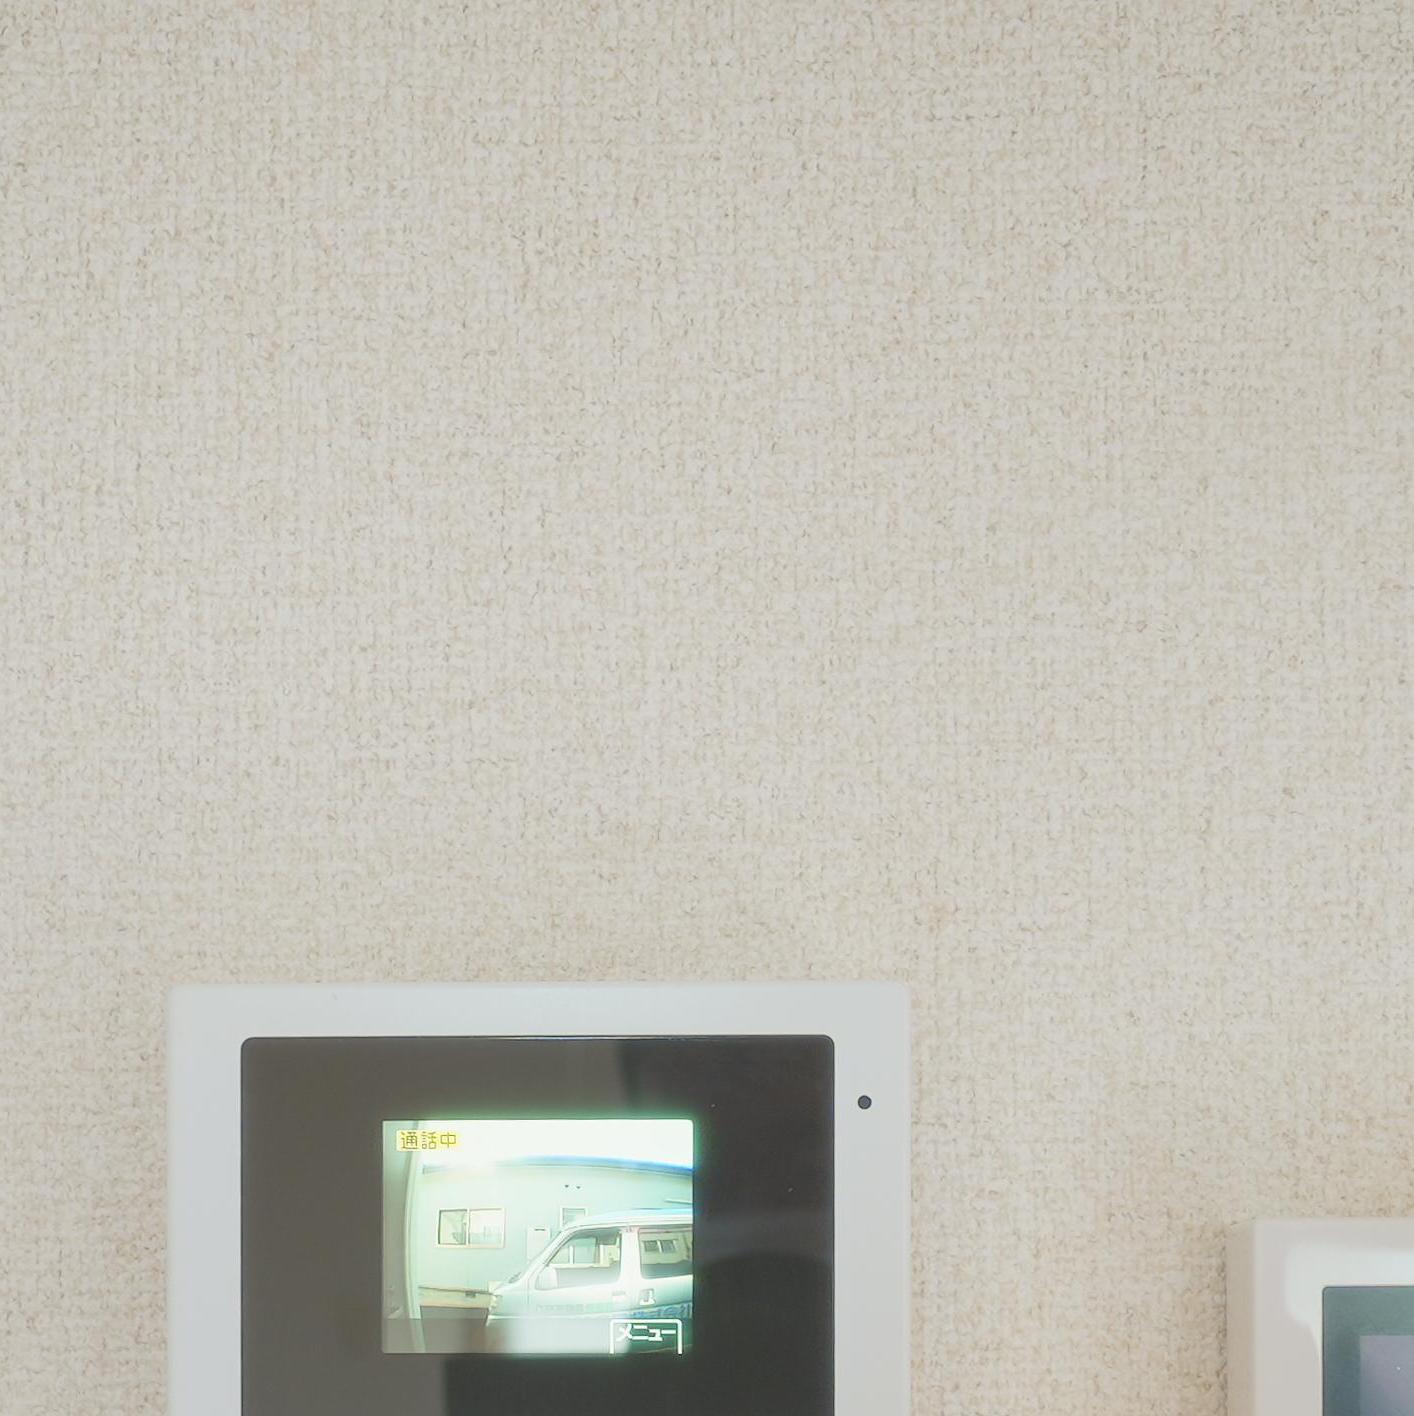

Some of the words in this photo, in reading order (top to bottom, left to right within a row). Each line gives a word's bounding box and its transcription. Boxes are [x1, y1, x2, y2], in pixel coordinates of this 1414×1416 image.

[401, 1131, 457, 1149] 通話中
[616, 1323, 677, 1342] メニュー
